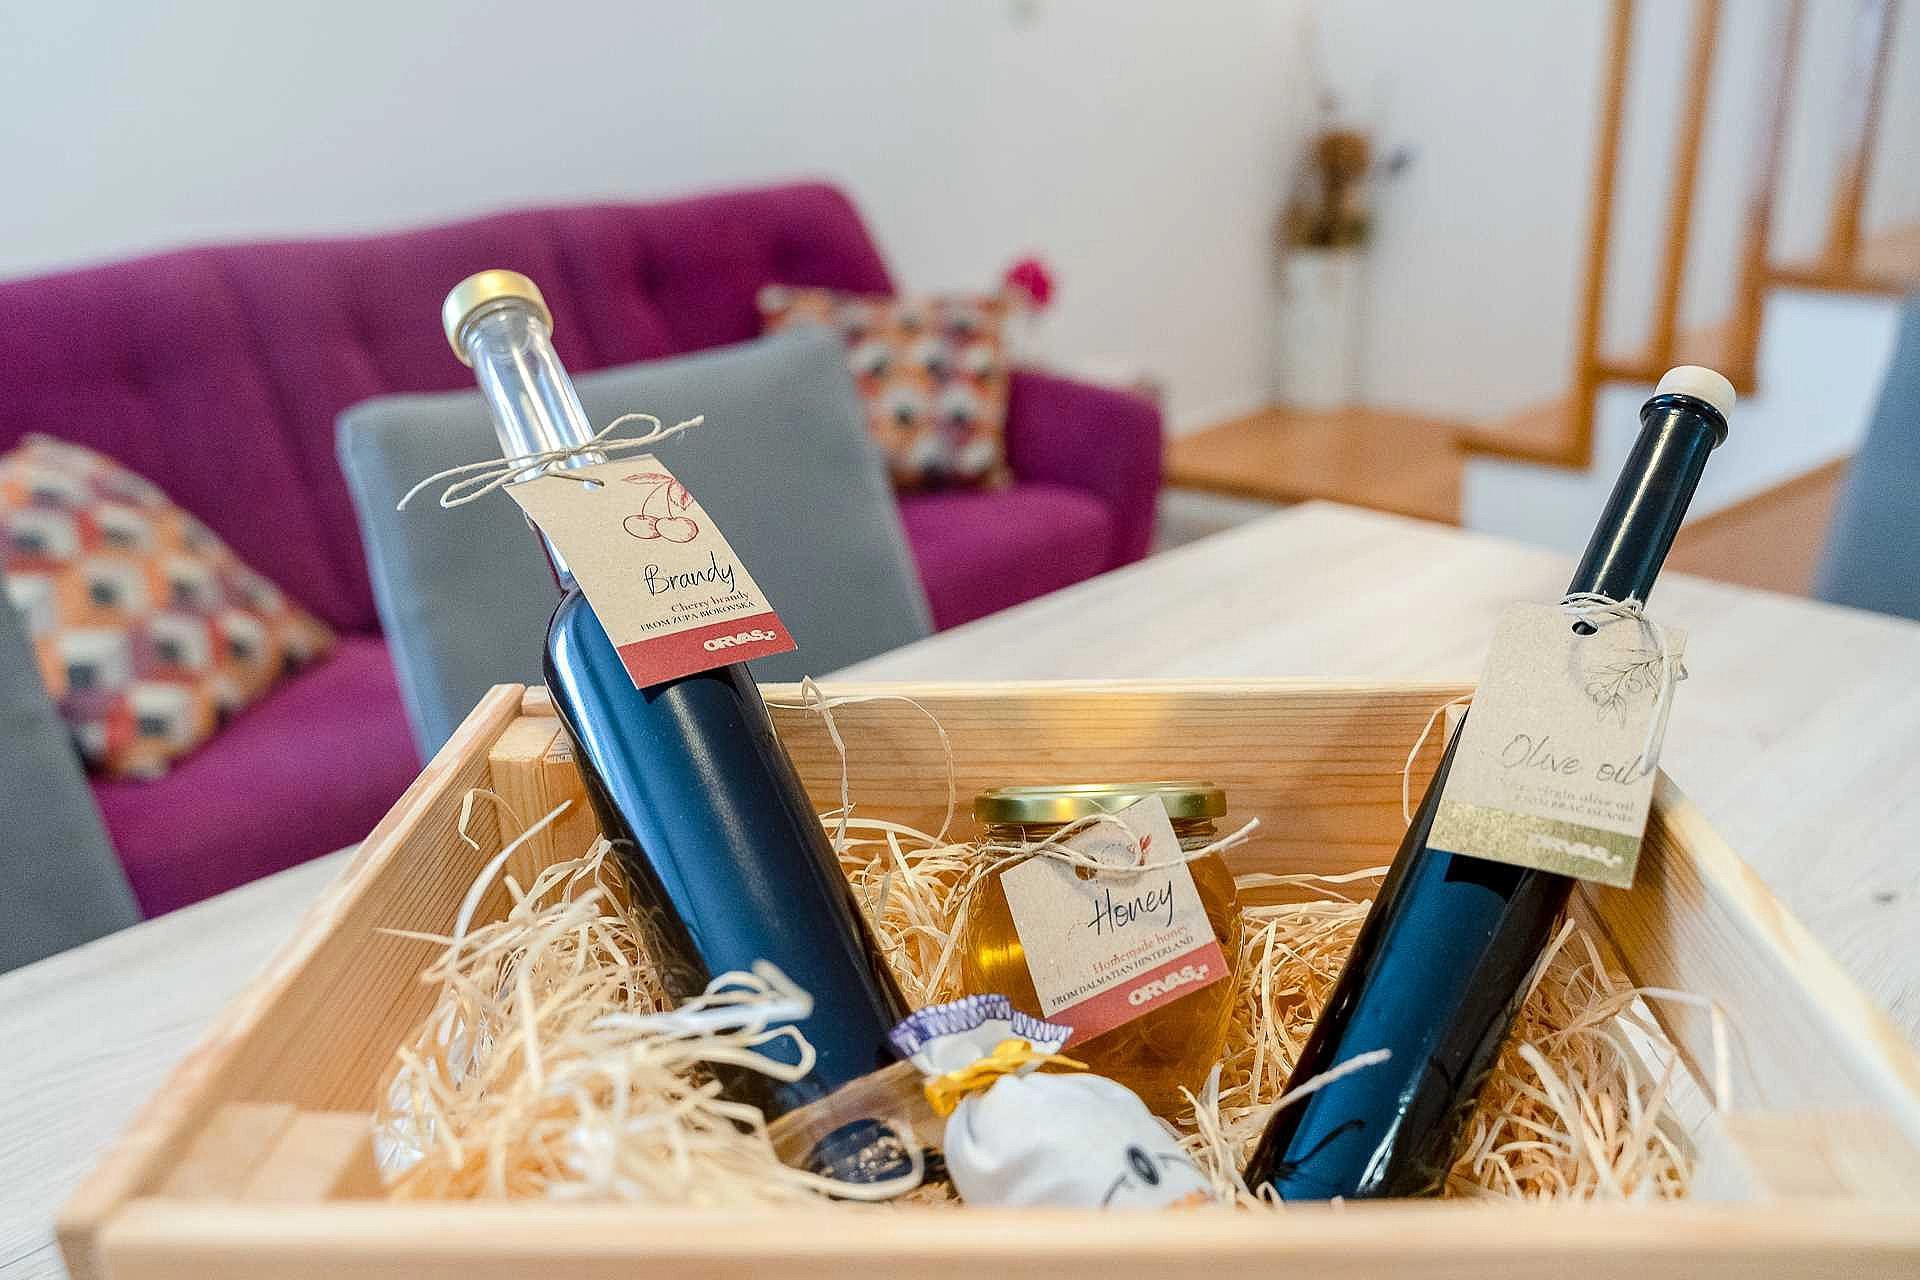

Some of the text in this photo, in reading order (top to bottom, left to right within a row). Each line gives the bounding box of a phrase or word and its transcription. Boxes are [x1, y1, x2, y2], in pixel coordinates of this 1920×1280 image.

[643, 551, 735, 597] Brandy
[640, 617, 672, 632] FROM
[699, 601, 755, 618] BIOKOVSKA
[671, 591, 751, 614] Cherry brandy
[1502, 733, 1642, 785] Olive oil
[1579, 792, 1612, 806] olive
[1615, 800, 1635, 812] oil
[1088, 880, 1173, 936] Honey
[1052, 934, 1194, 1007] FROM DALMATIAN HINTERLAND
[1092, 922, 1189, 974] Homemade honey
